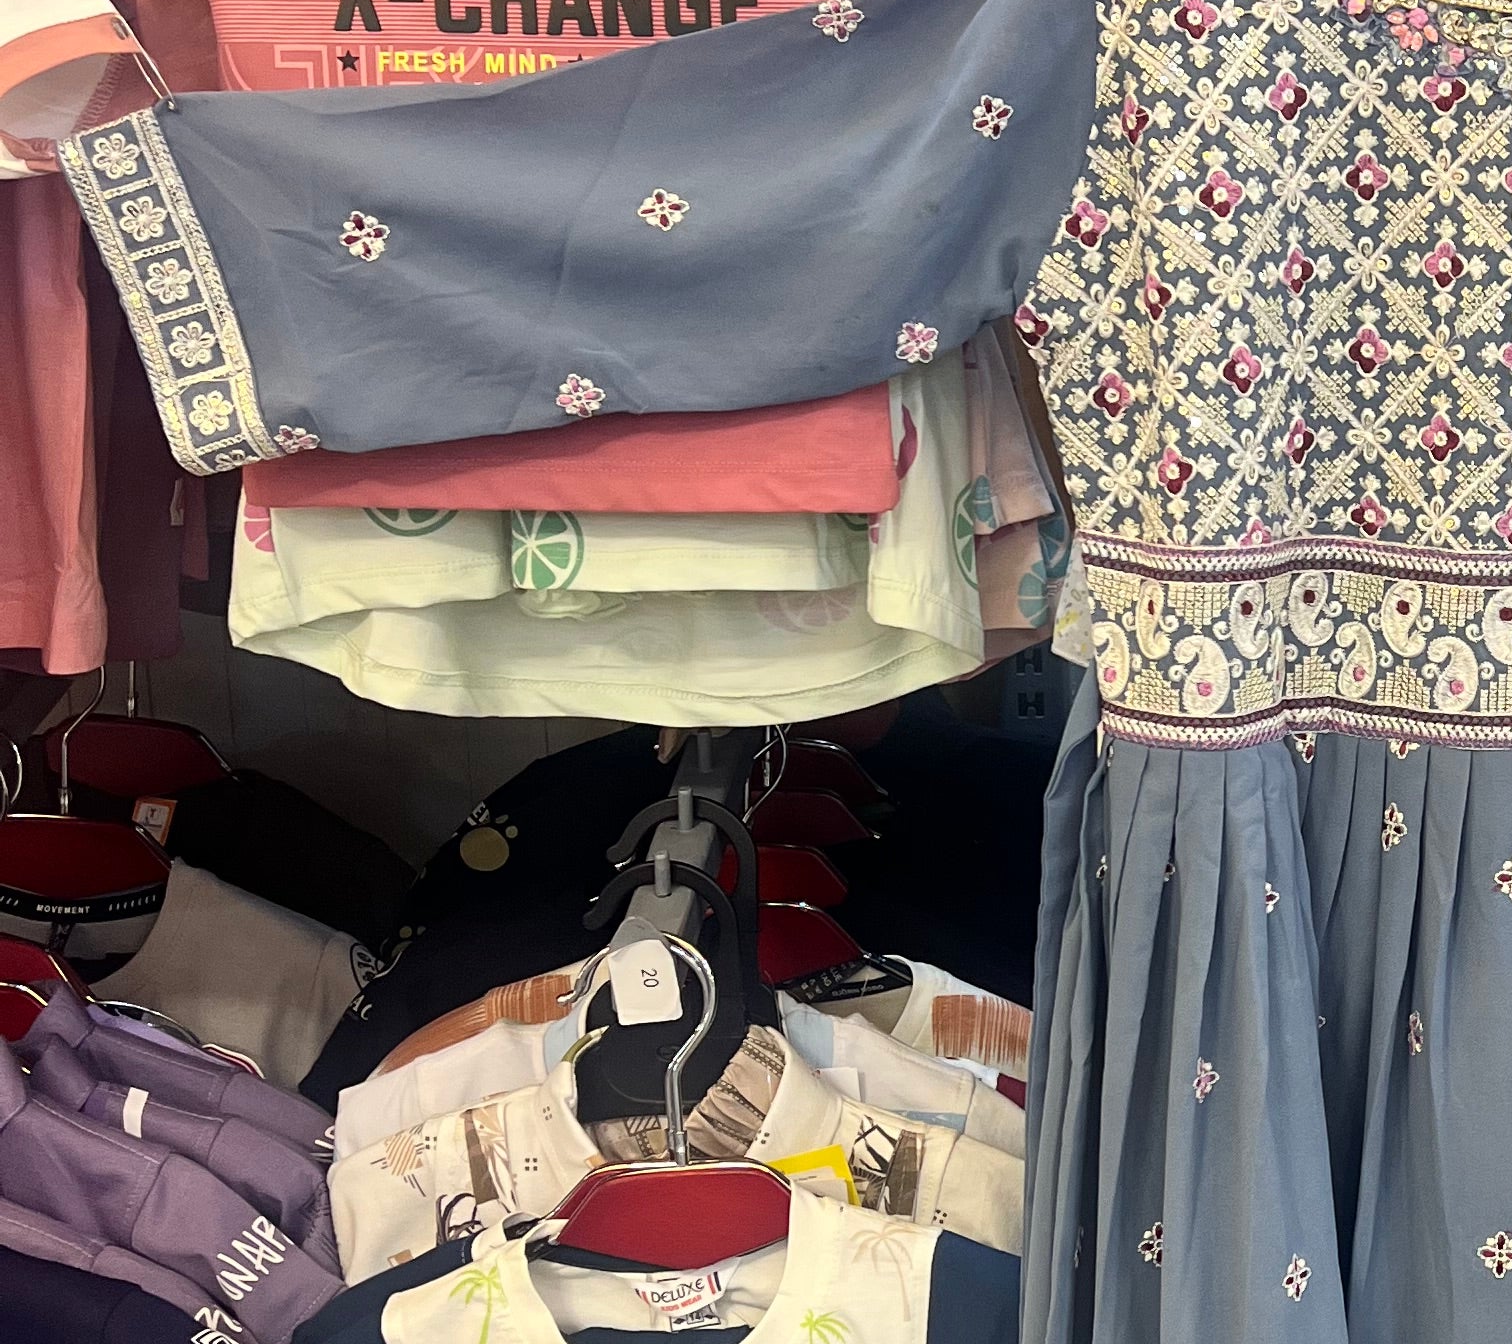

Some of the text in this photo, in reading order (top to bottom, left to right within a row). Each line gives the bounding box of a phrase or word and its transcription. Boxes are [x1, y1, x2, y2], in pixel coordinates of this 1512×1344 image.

[377, 50, 558, 75] FRESH MIND
[36, 903, 91, 915] MOVEMENT
[640, 967, 660, 988] 20
[650, 1277, 706, 1304] DELUXE
